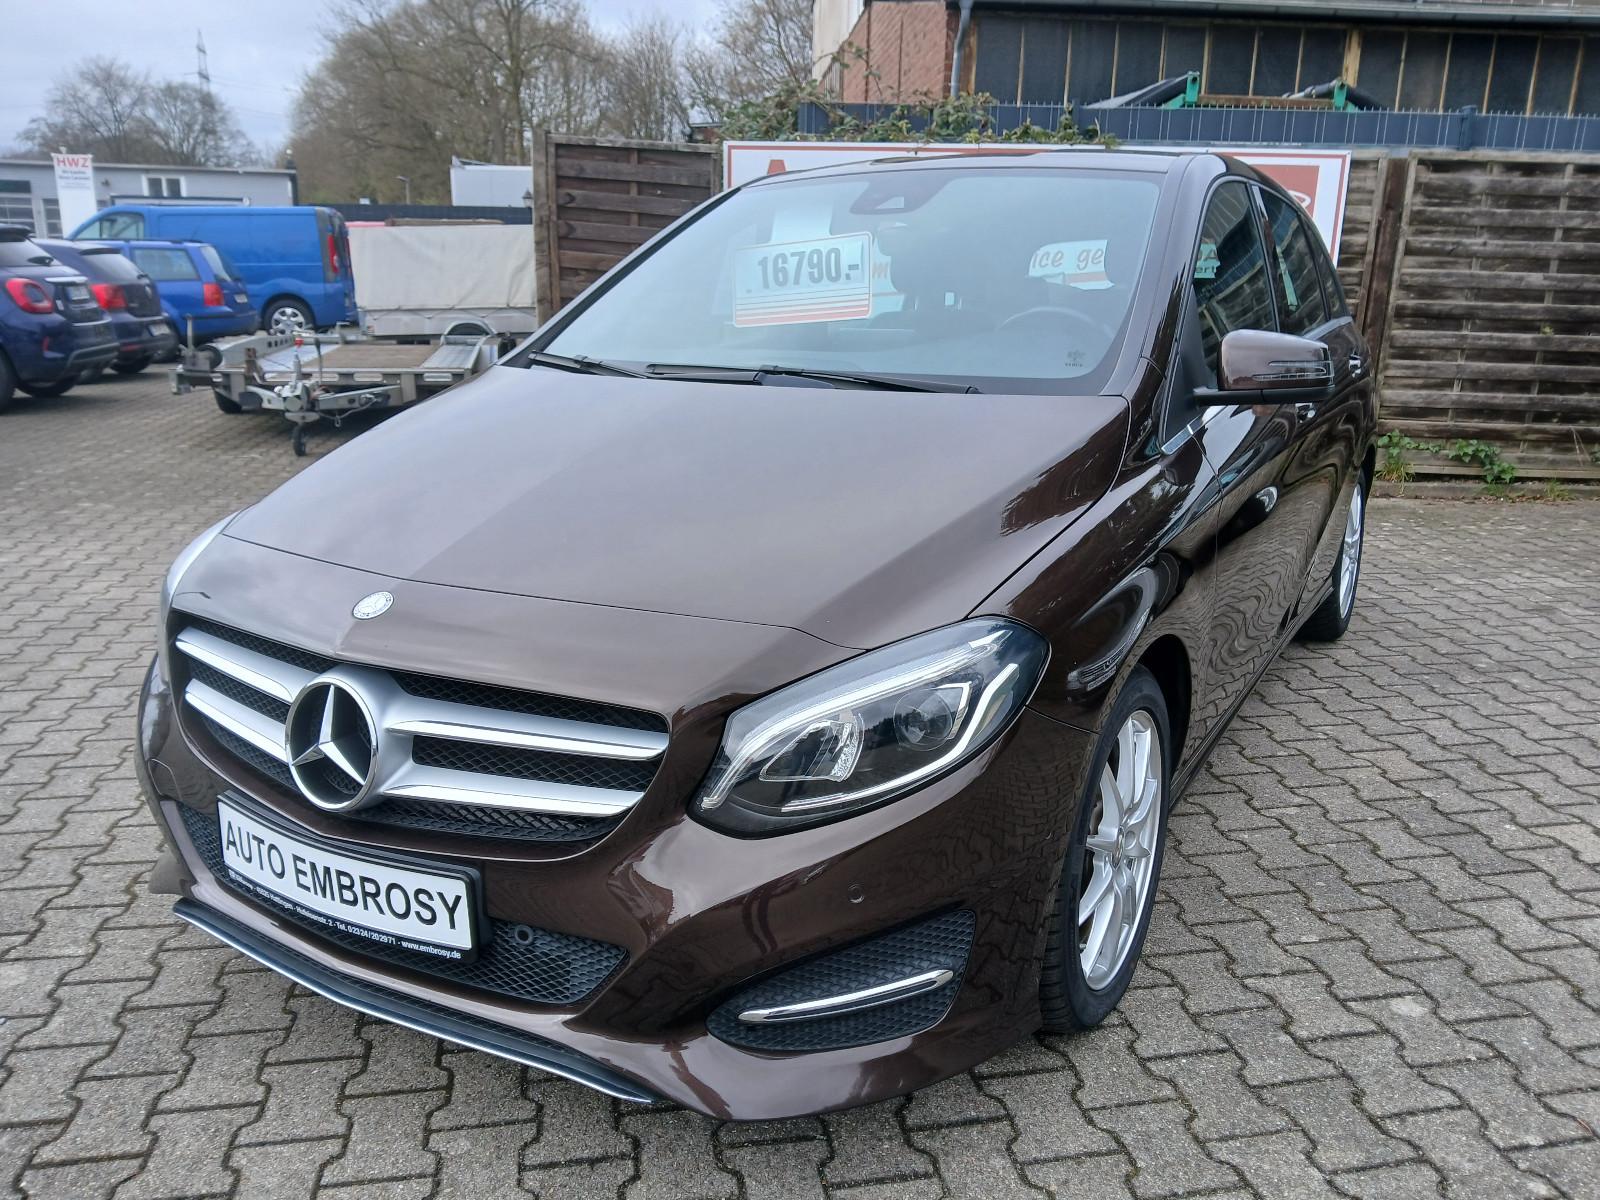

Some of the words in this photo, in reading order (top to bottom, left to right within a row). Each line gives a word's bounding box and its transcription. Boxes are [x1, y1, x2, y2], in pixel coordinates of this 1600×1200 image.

[57, 156, 89, 168] HWZ
[226, 820, 286, 880] AUTO
[292, 853, 462, 931] EMBROSY
